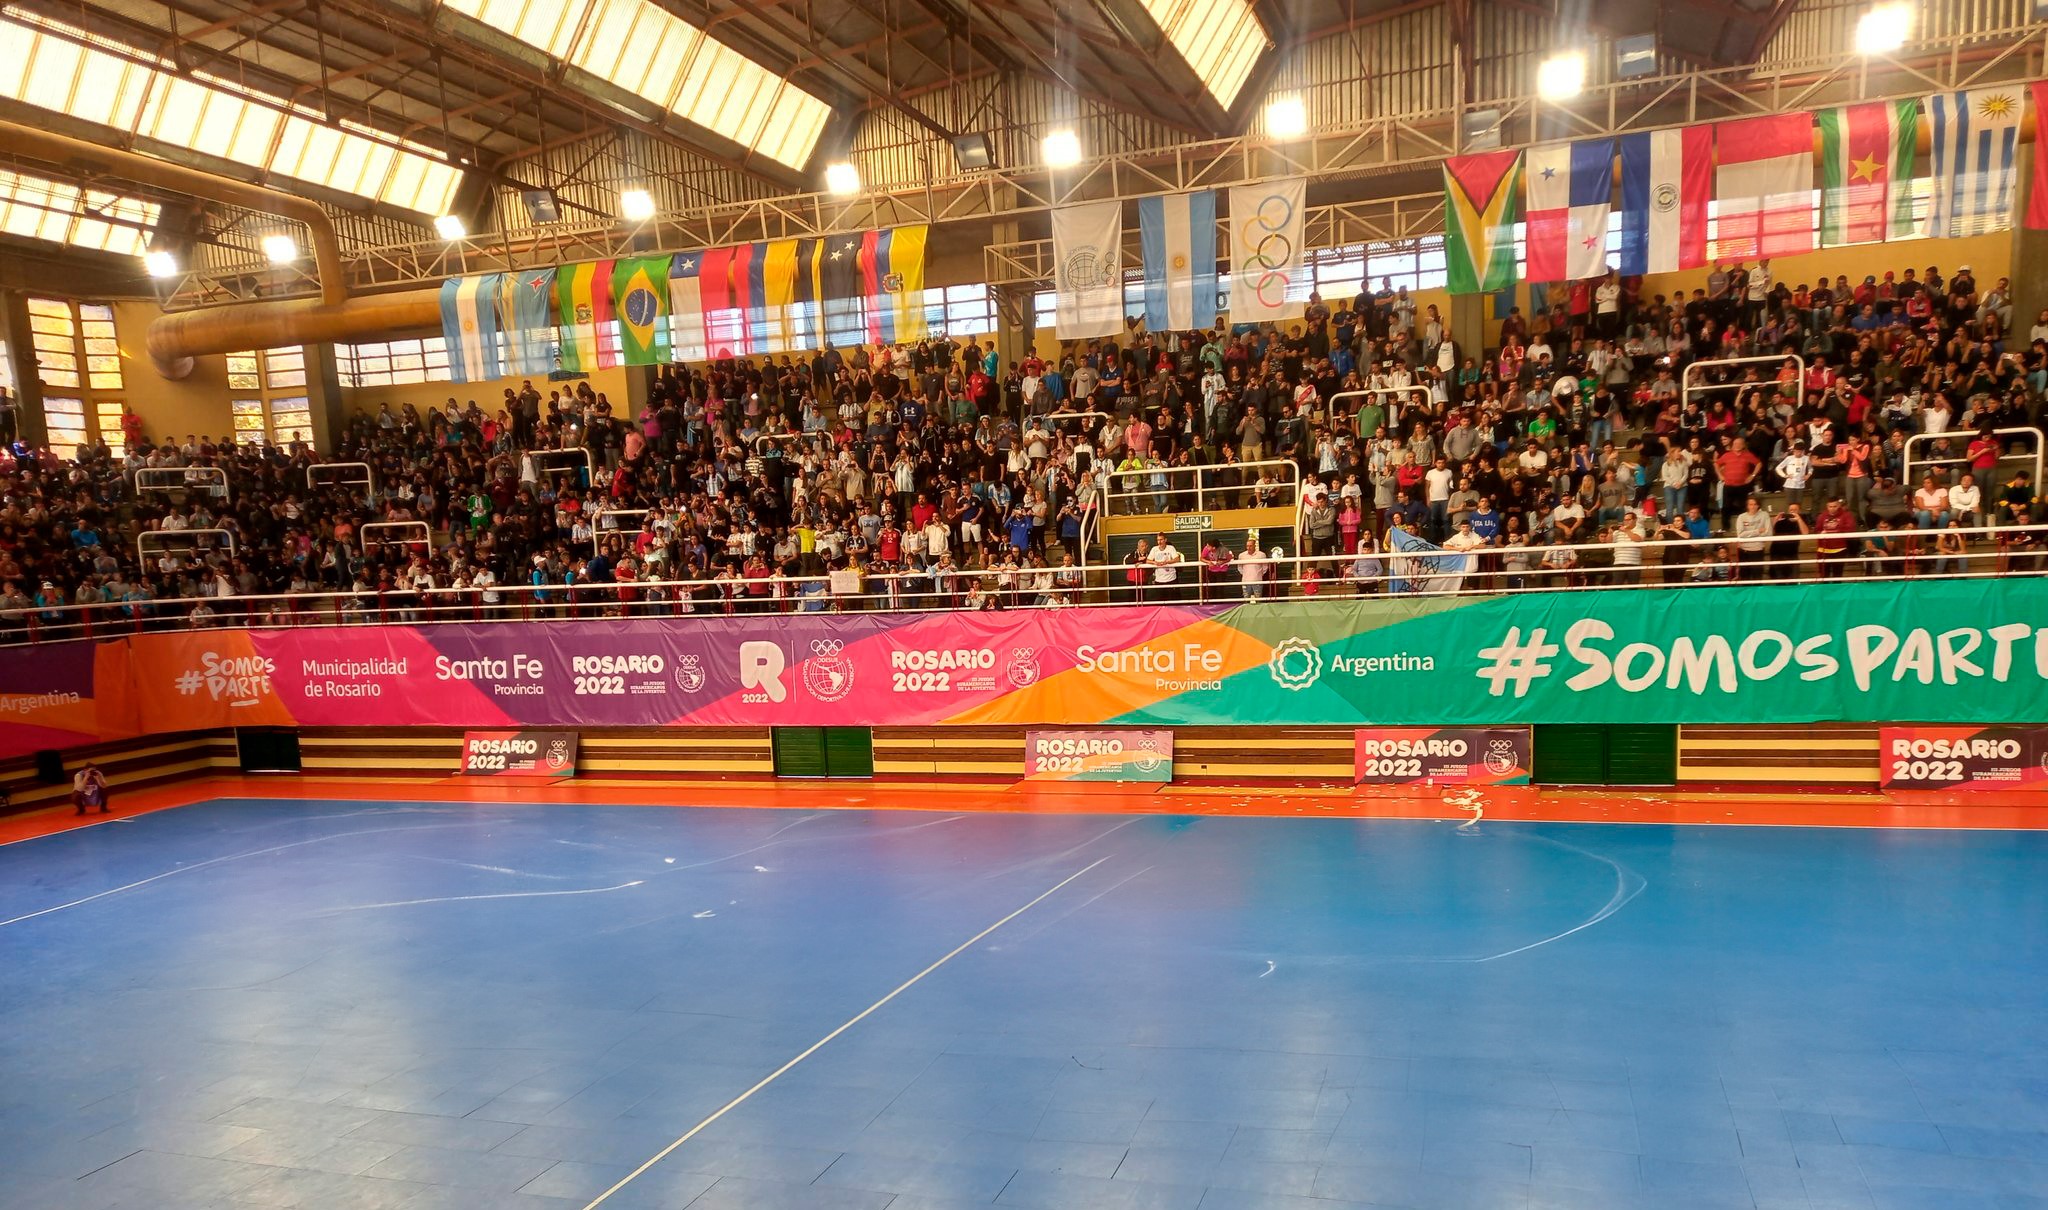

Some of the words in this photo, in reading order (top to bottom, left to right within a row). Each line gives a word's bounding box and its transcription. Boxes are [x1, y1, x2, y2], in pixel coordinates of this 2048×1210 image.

[1175, 517, 1200, 525] SALIDA
[1076, 645, 1174, 672] Santa
[1184, 644, 1222, 672] Fe
[1331, 652, 1434, 677] Argentina
[302, 657, 407, 680] Municipalidad
[435, 655, 507, 680] Santa
[513, 654, 543, 679] Fe
[304, 680, 323, 697] de
[326, 680, 381, 697] Rosario
[494, 683, 544, 695] Provincia
[574, 676, 625, 694] 2022
[892, 672, 950, 692] 2022
[1156, 678, 1222, 690] Provincia
[0, 689, 80, 714] Argentina
[742, 694, 768, 703] 2022
[467, 755, 506, 769] 2022
[1036, 757, 1084, 772] 2022
[1365, 759, 1422, 776] 2022
[1892, 761, 1964, 780] 2022
